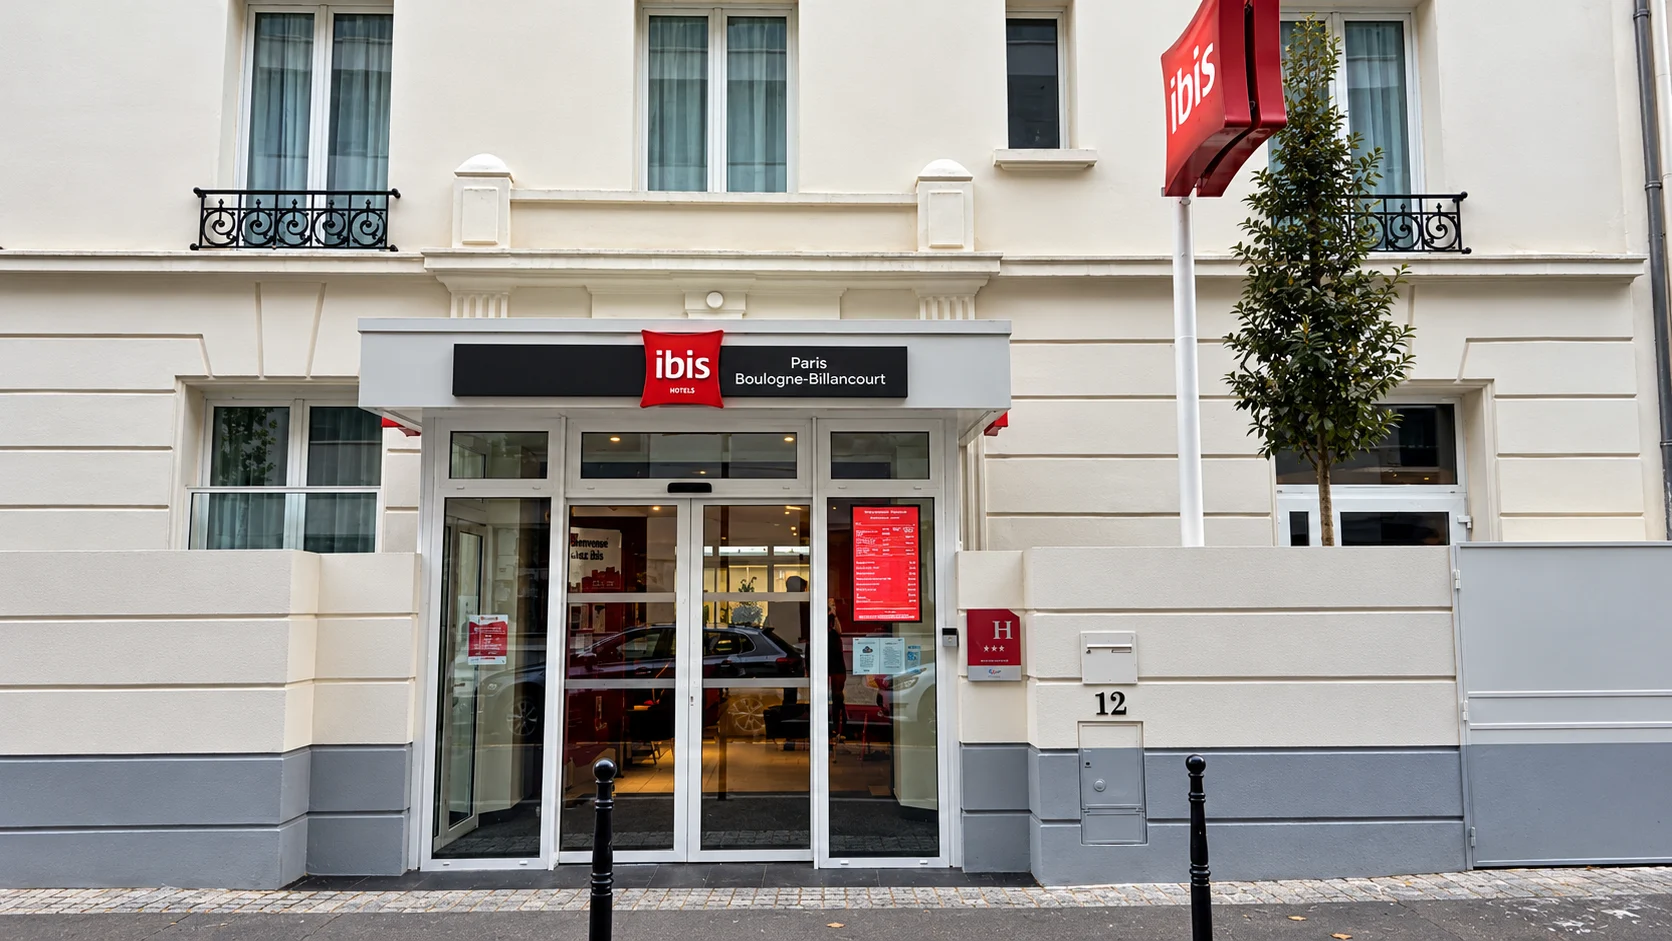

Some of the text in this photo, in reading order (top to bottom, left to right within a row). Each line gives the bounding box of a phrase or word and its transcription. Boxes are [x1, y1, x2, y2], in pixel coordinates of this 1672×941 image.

[1170, 43, 1216, 135] ibis
[655, 349, 711, 379] ibis
[791, 356, 828, 369] Paris
[735, 372, 886, 388] Boulogne-Billancourt
[992, 620, 1013, 640] H
[1095, 691, 1127, 716] 12
